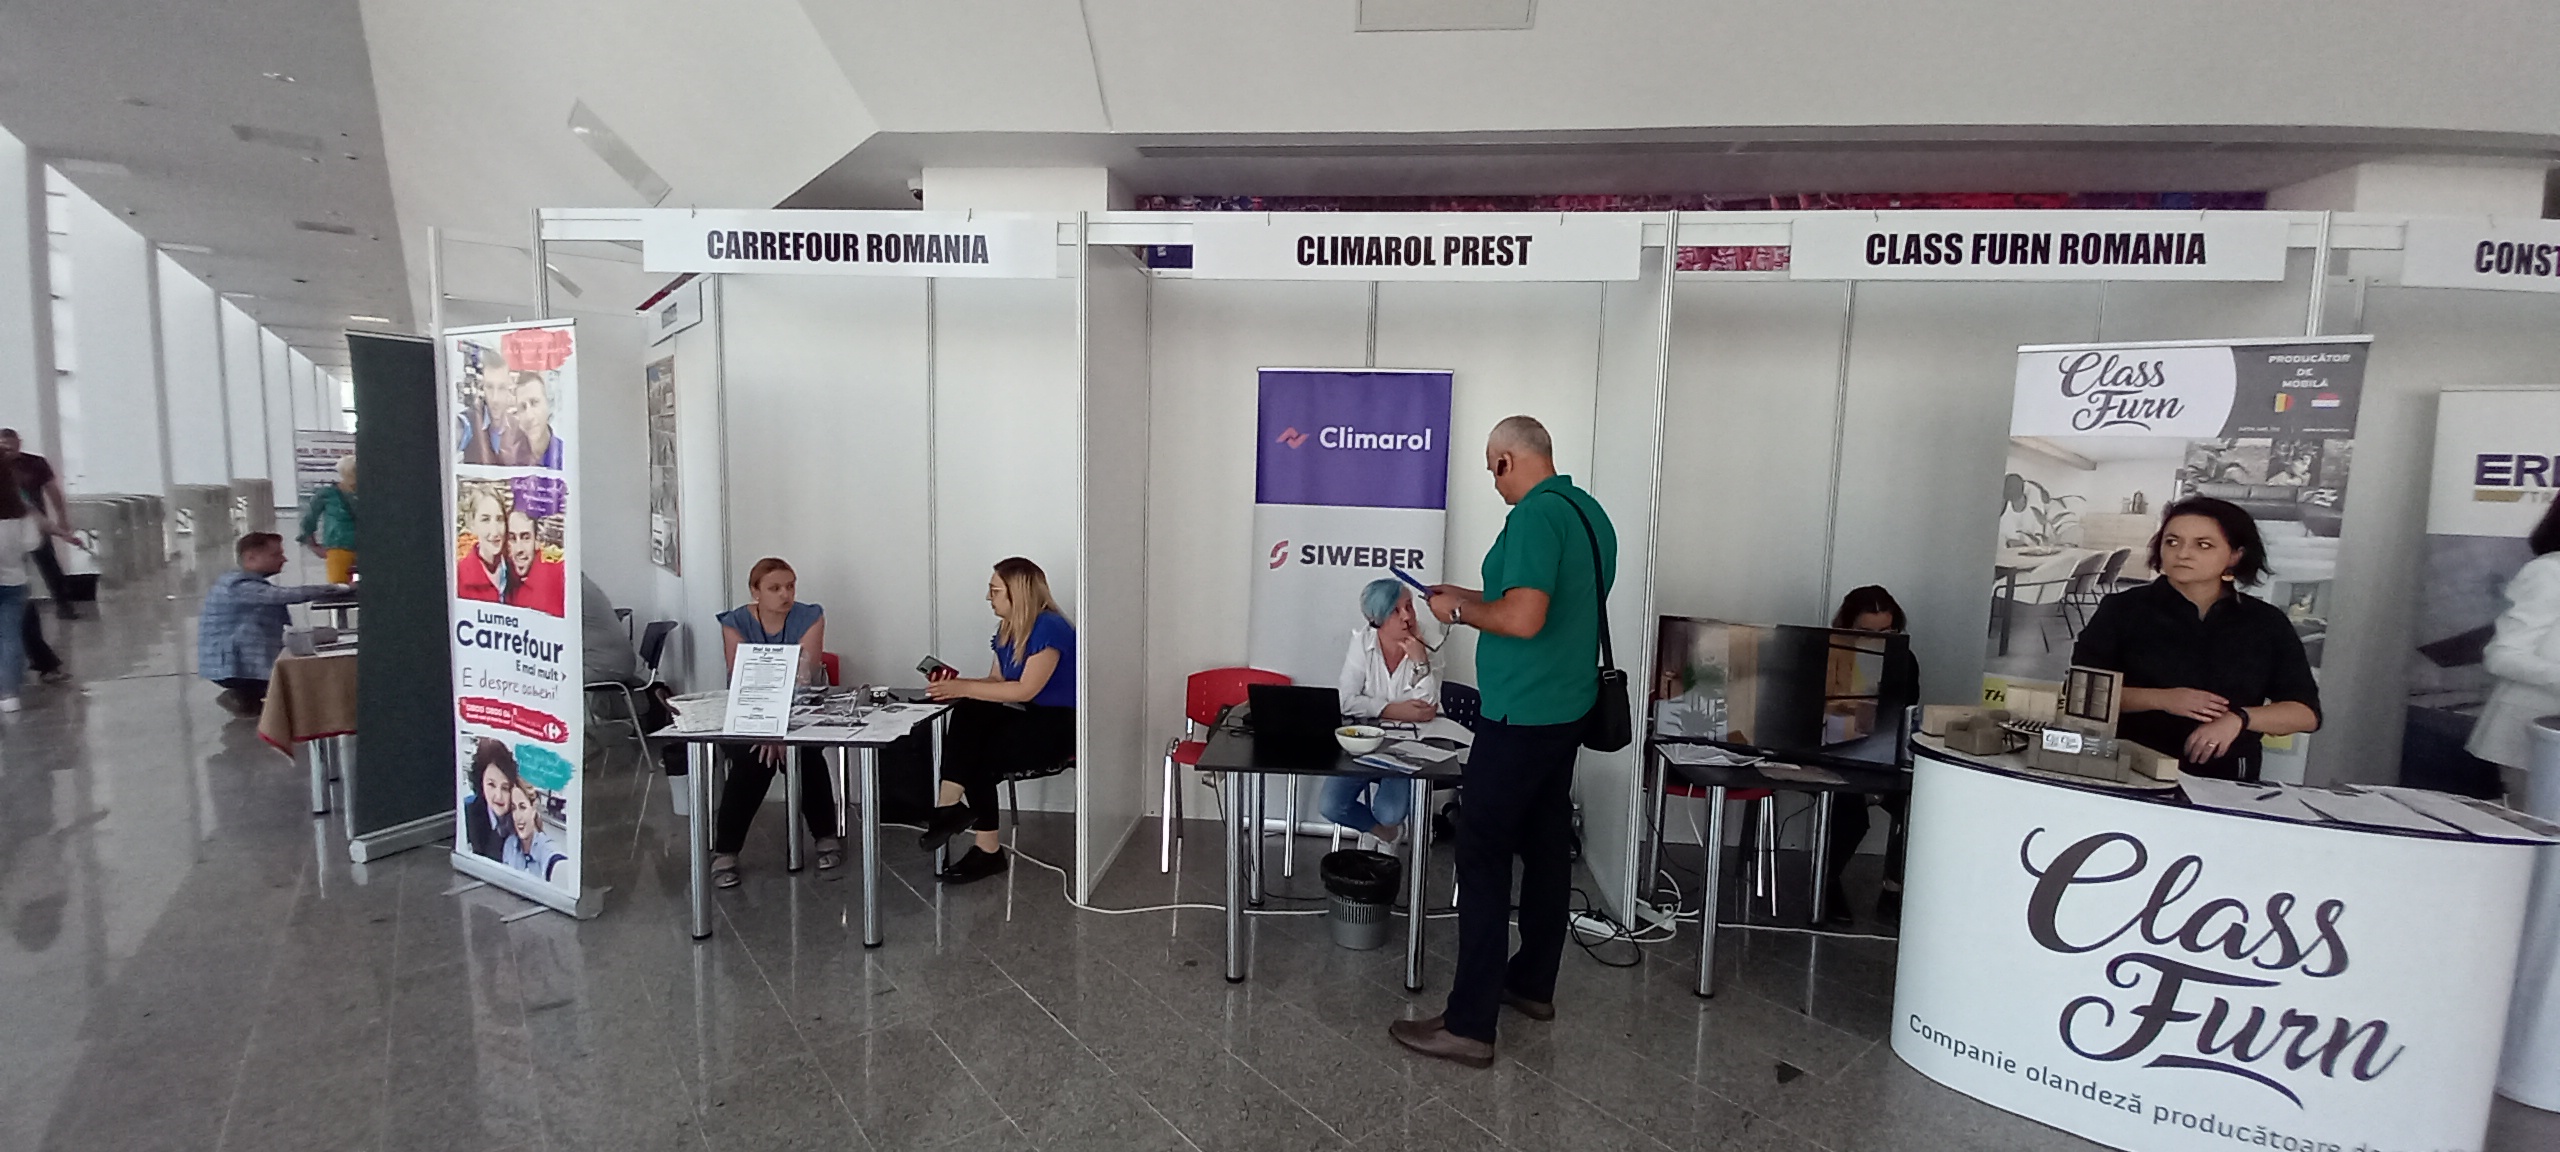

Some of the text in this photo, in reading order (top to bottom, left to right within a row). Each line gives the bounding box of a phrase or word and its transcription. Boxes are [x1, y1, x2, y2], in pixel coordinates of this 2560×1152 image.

[706, 230, 989, 264] CARREFOUR ROMANIA
[1297, 235, 1533, 266] CLIMAROL PREST
[1866, 232, 2206, 265] CLASS FURN ROMANIA
[2059, 352, 2165, 397] Class
[2296, 368, 2314, 376] DE
[2072, 390, 2185, 431] Furn
[1319, 426, 1432, 451] Climarol
[1300, 544, 1424, 570] SIWEBER
[477, 609, 519, 628] Lumea
[456, 620, 564, 663] Carrefour
[463, 667, 473, 687] E
[480, 670, 519, 696] despre
[516, 660, 521, 671] E
[2020, 827, 2350, 978] Class
[2058, 952, 2406, 1108] Furn
[1909, 1014, 2017, 1074] Companie
[2026, 1065, 2142, 1115] olandeză
